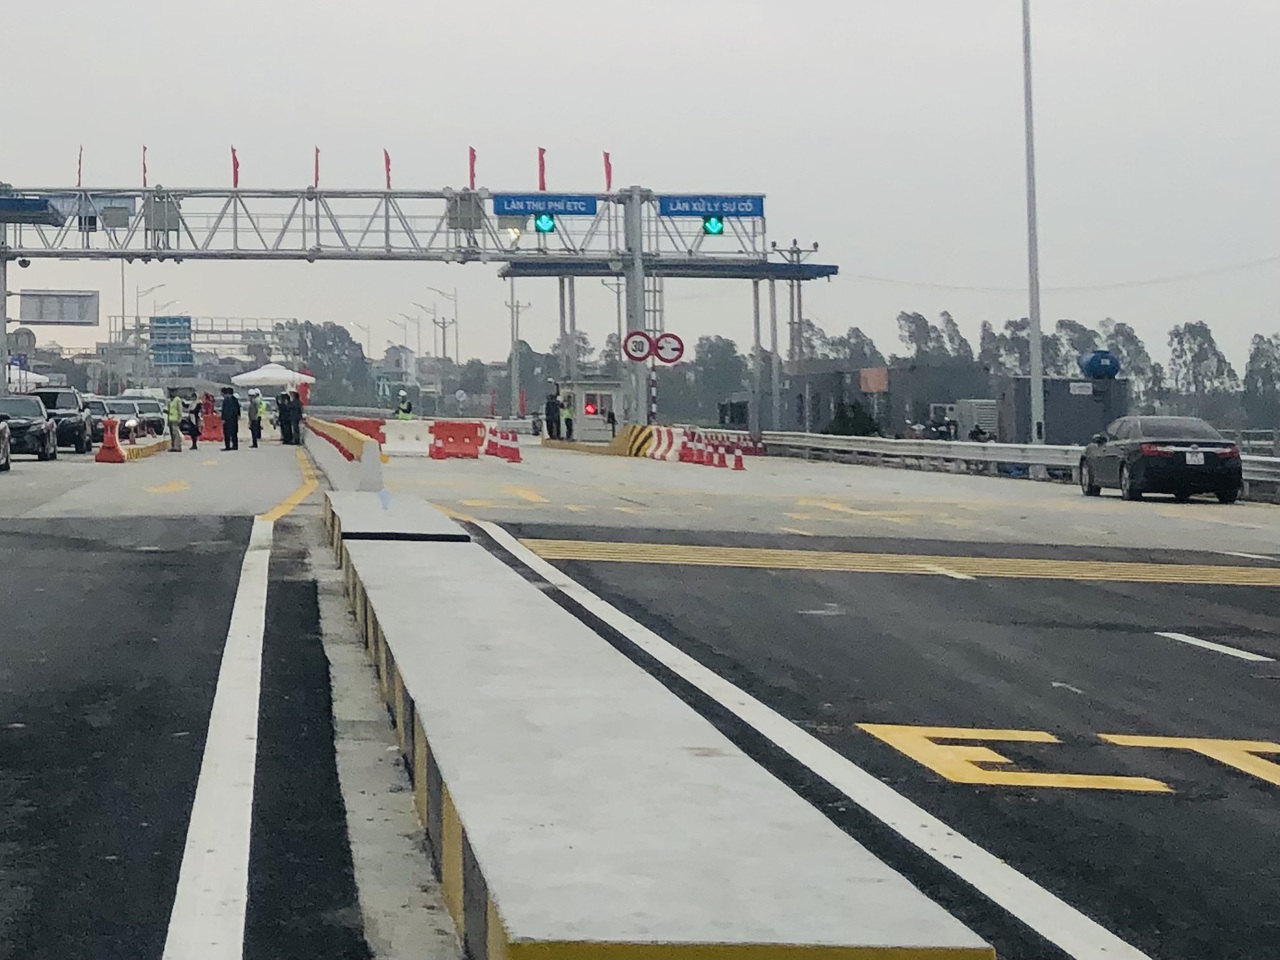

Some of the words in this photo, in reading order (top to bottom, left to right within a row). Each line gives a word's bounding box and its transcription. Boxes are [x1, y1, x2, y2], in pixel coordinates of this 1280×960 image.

[504, 199, 524, 210] LÀN
[566, 200, 587, 211] ETC
[632, 340, 644, 352] 30
